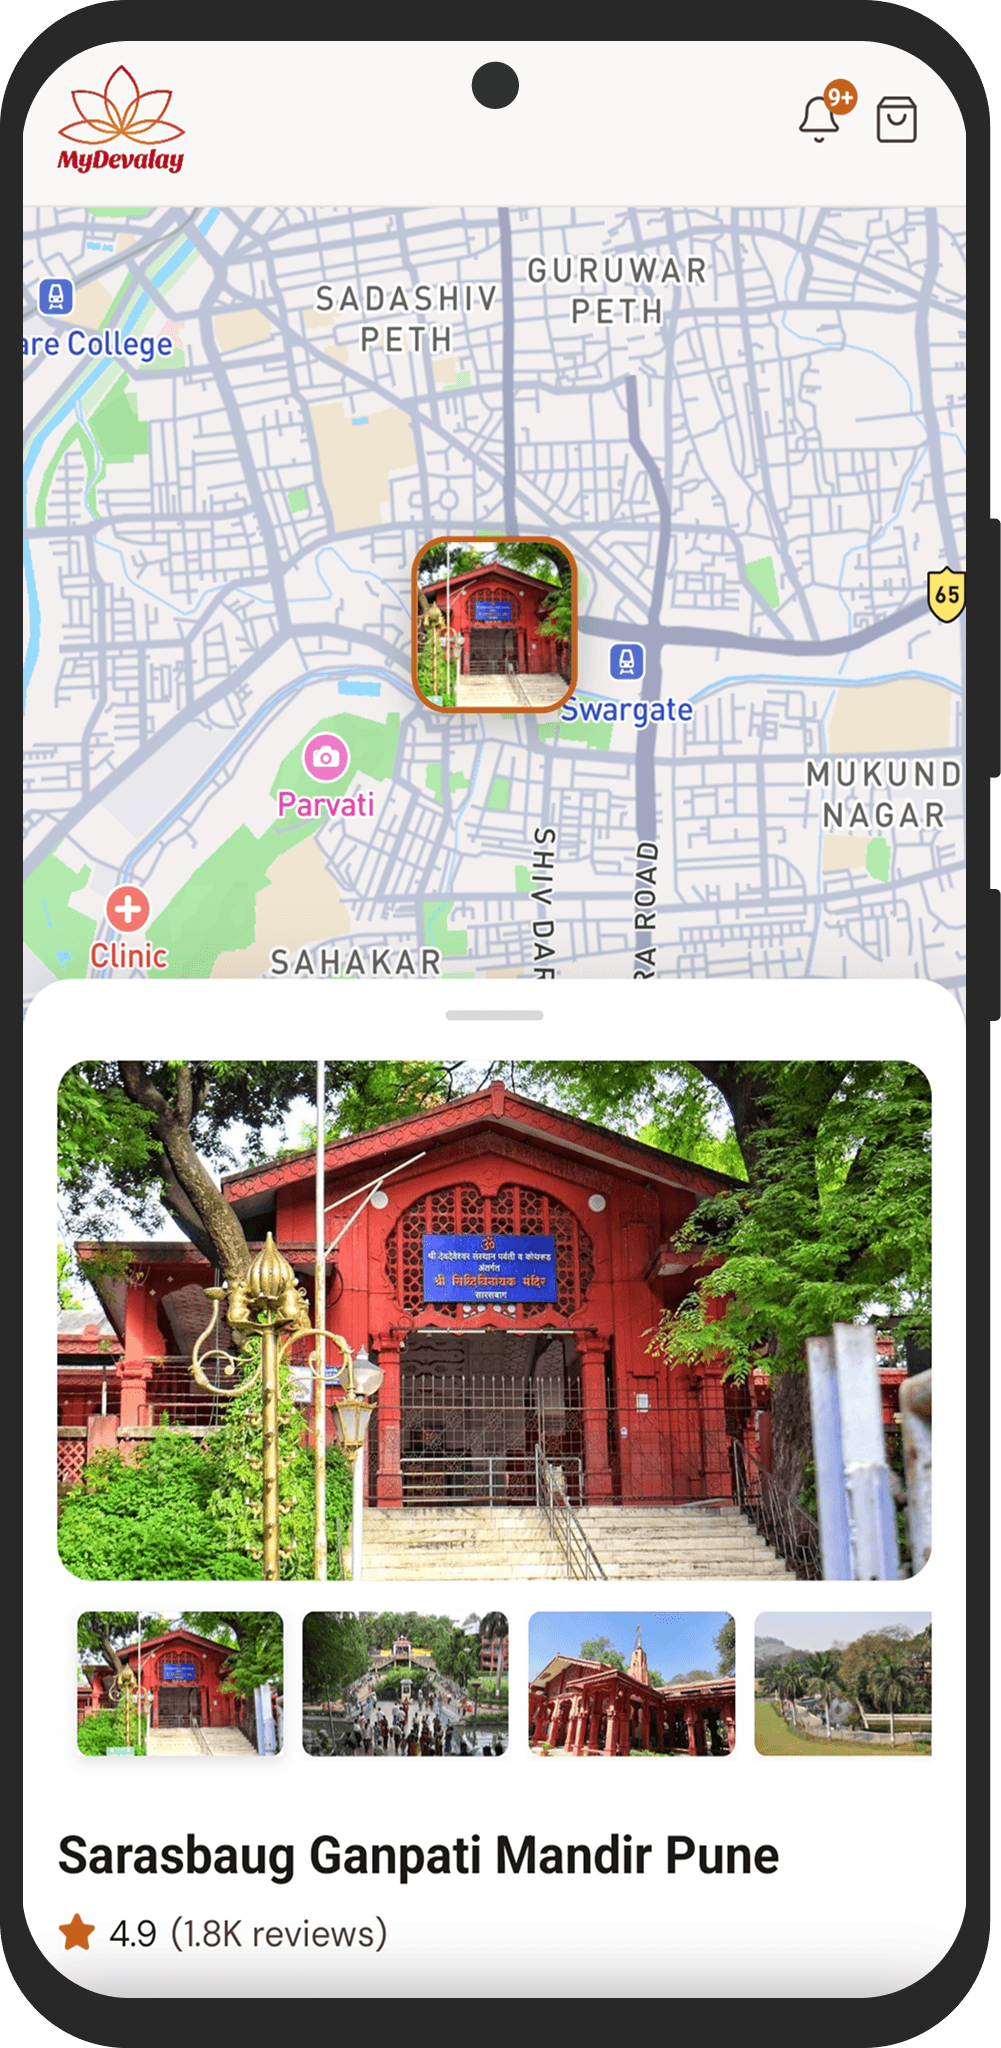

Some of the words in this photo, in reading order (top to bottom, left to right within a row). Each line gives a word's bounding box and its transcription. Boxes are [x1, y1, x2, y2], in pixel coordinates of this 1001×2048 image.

[828, 87, 854, 107] 9+
[57, 149, 185, 174] MyDevalay
[528, 257, 705, 283] GURUWAR
[317, 285, 496, 311] SADASHIV
[572, 298, 661, 324] PETH
[68, 330, 172, 363] College
[362, 326, 450, 352] PETH
[935, 585, 960, 604] 65
[561, 696, 693, 728] Swargate
[807, 761, 960, 787] MUKUND
[279, 791, 374, 818] Parvati
[824, 802, 943, 828] NAGAR
[531, 827, 556, 905] SHIV
[634, 842, 659, 929] ROAD
[91, 942, 167, 970] Clinic
[271, 949, 440, 975] SAHAKAR
[58, 1834, 294, 1884] Sarasbaug
[310, 1834, 481, 1884] Ganpati
[497, 1834, 653, 1875] Mandir
[667, 1836, 779, 1875] Pune
[109, 1919, 157, 1948] 4.9
[171, 1915, 243, 1953] (1.8K
[253, 1915, 388, 1953] reviews)
